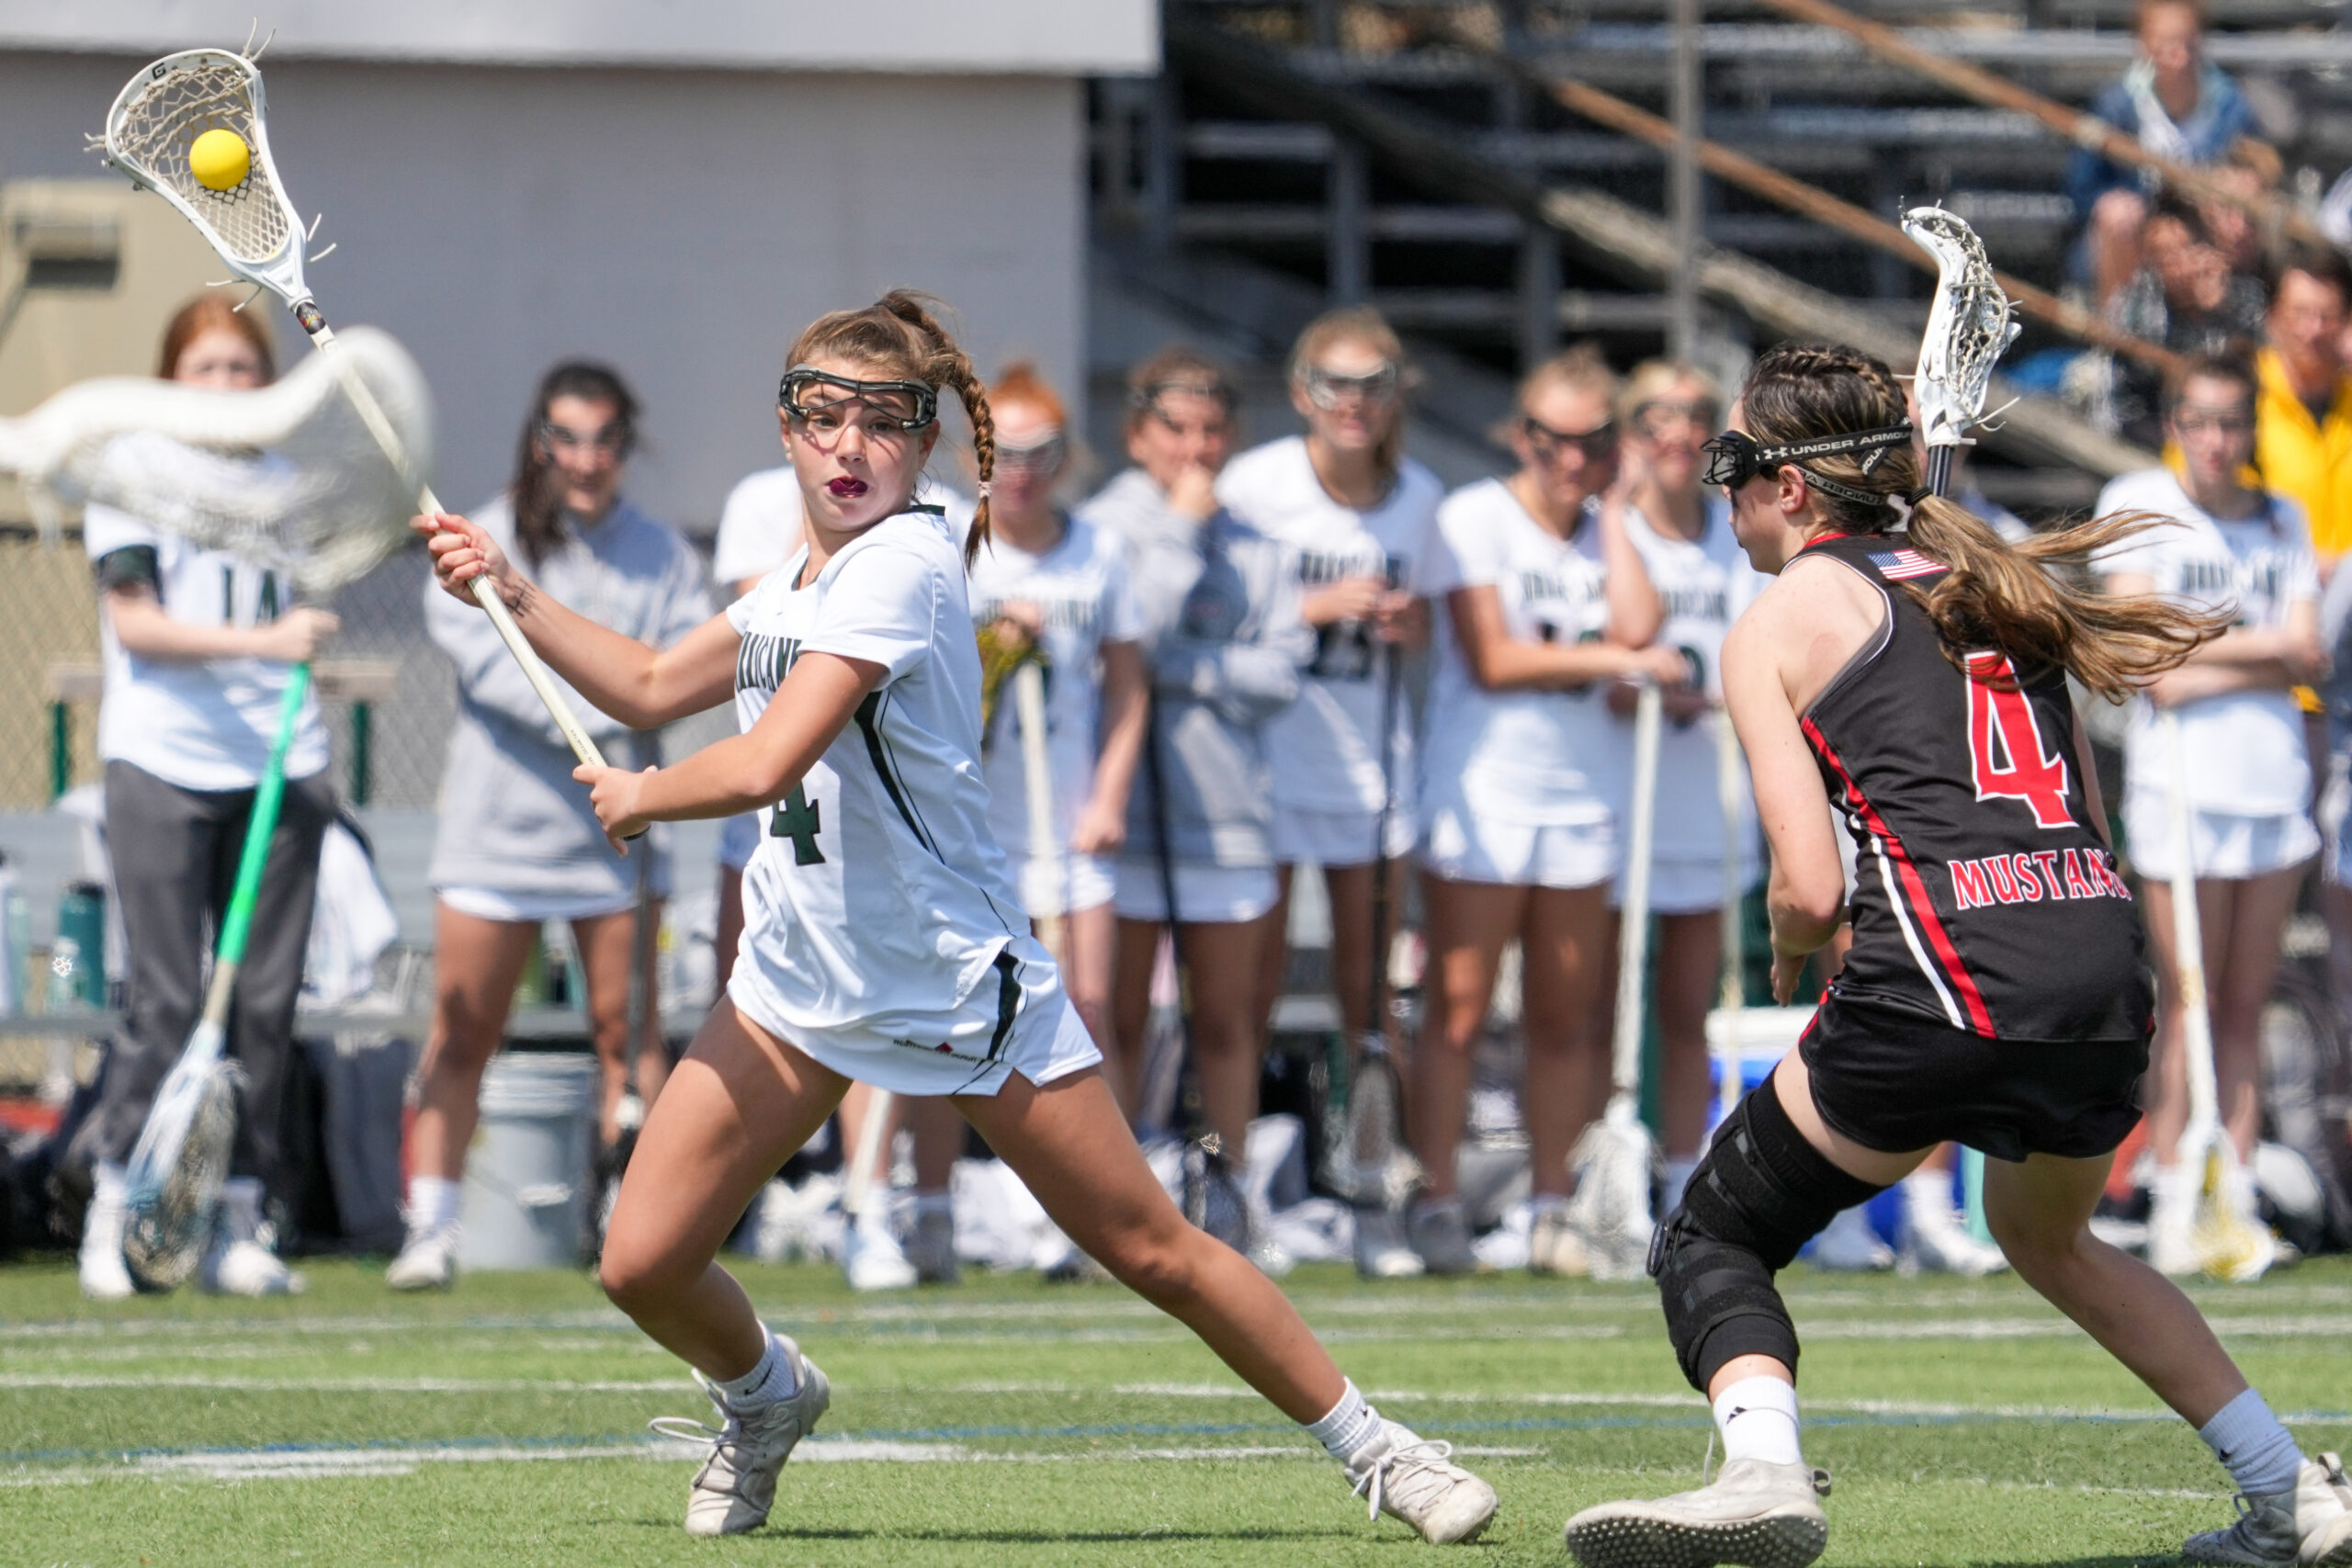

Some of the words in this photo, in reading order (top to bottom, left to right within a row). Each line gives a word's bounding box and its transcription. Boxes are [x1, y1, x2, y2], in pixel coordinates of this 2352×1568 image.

[1791, 439, 1854, 456] UNDER
[1964, 649, 2081, 829] 4
[770, 779, 827, 867] 4
